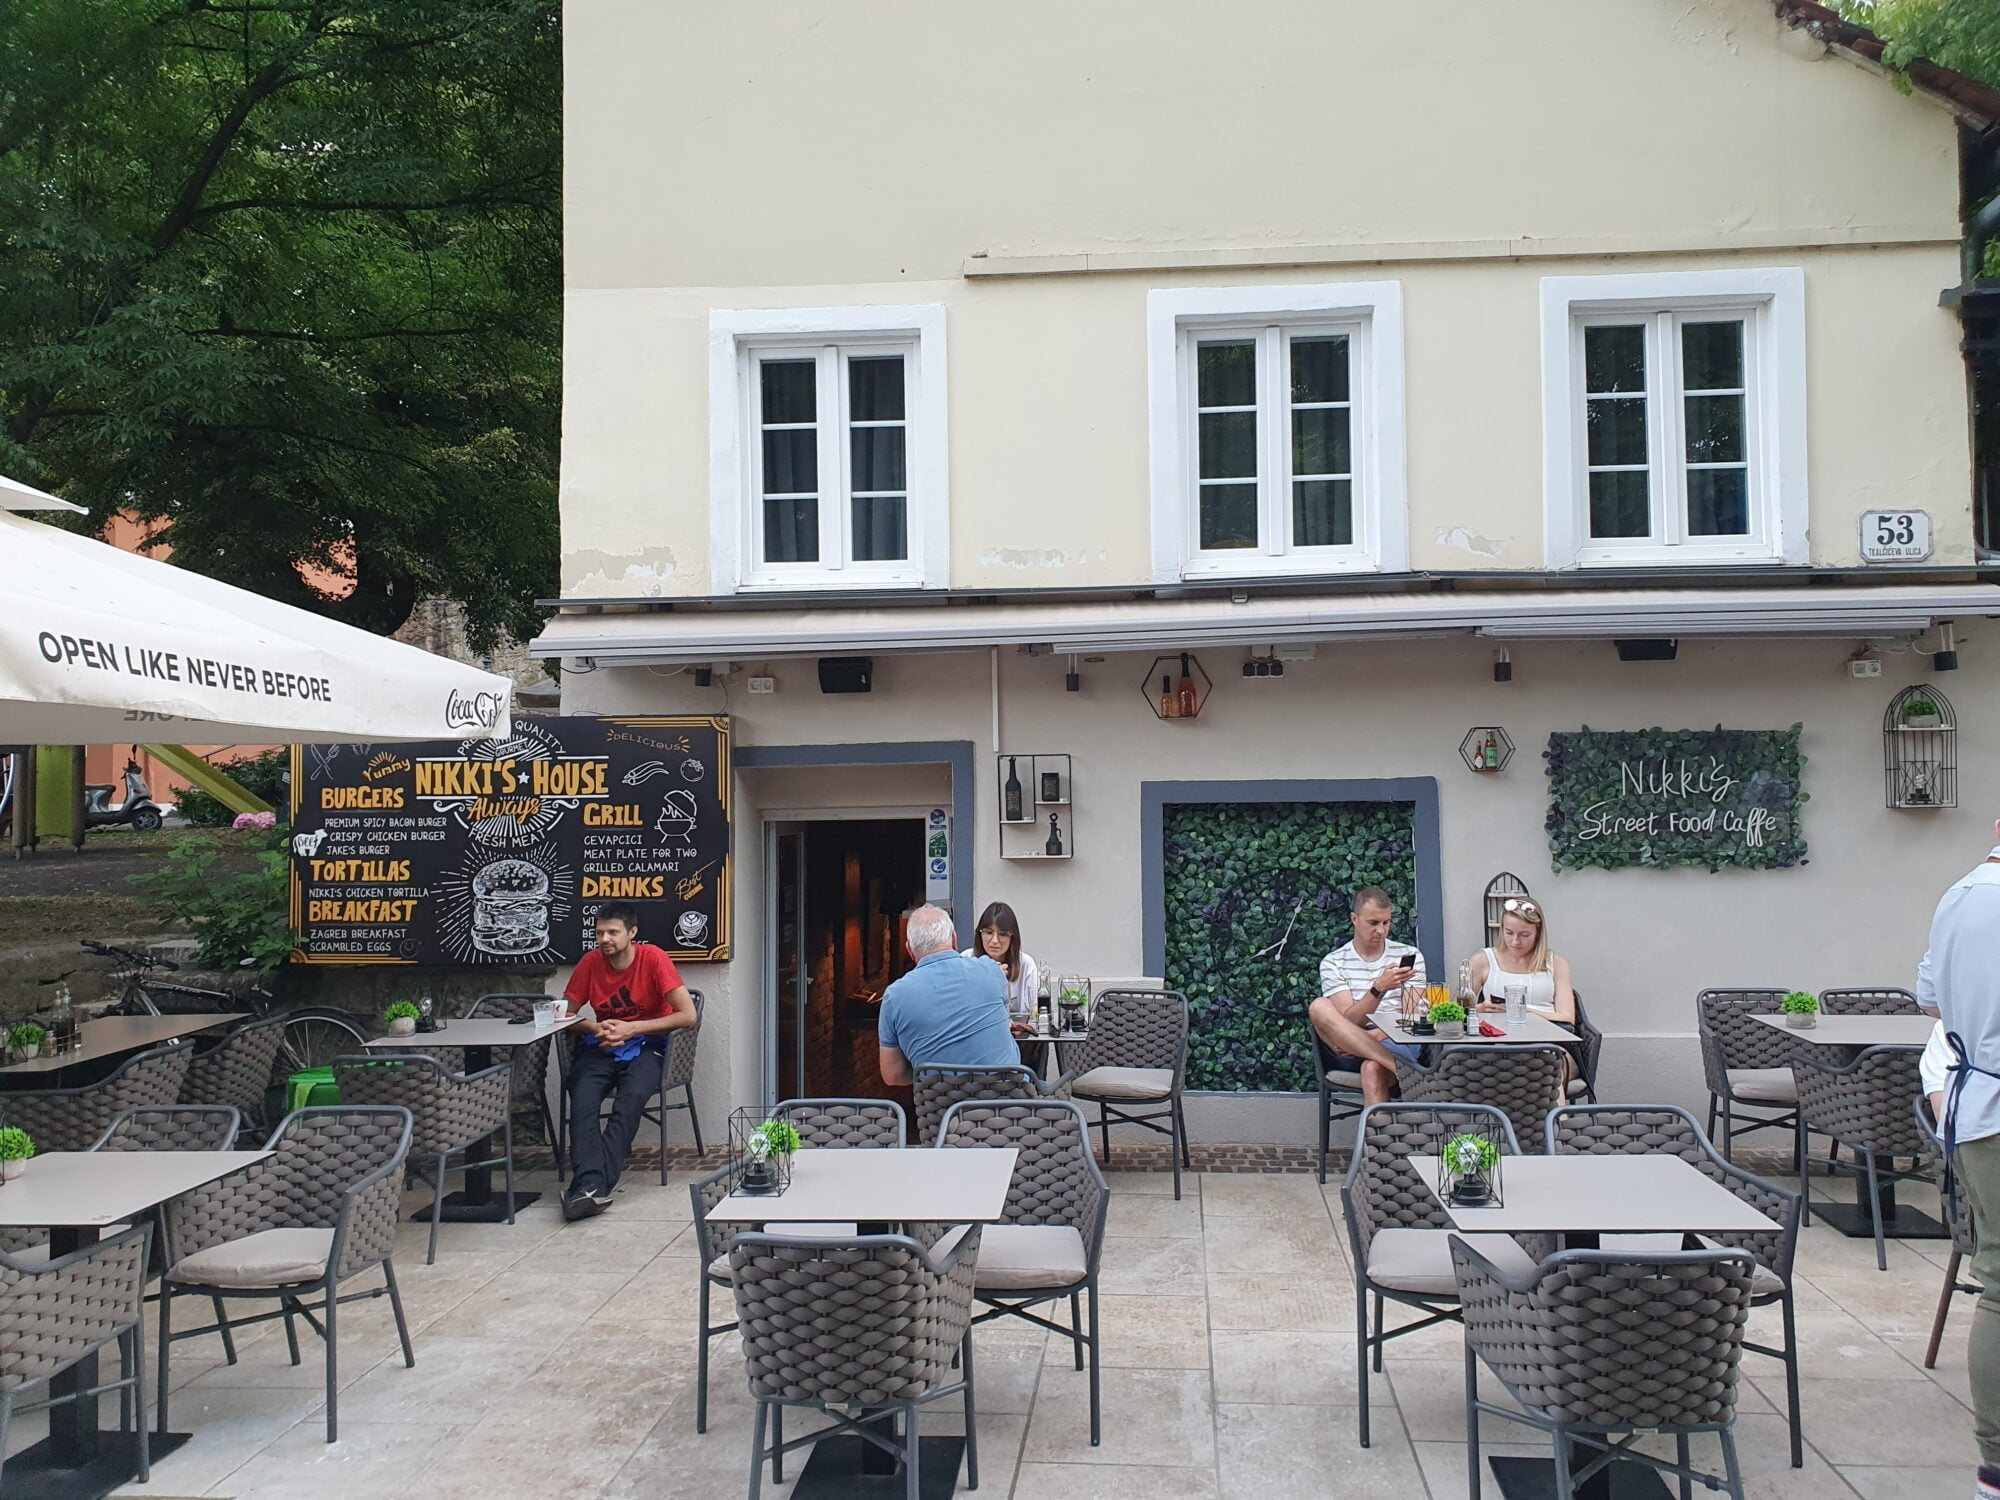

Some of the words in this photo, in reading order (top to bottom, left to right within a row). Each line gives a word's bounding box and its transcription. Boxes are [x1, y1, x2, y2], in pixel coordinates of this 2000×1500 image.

[1876, 514, 1914, 546] 53
[1905, 547, 1922, 556] ULICA
[38, 631, 120, 672] OPEN
[125, 645, 181, 682] LIKE
[186, 656, 258, 694] NEVER
[262, 669, 332, 702] BEFORE
[515, 720, 567, 754] QUALITY
[613, 732, 681, 751] DELICIOUS
[495, 741, 529, 757] GOURMET
[362, 758, 411, 782] Yummy
[415, 759, 517, 795] NIKKI'S
[533, 759, 610, 796] HOUSE
[1620, 755, 1740, 802] Nikki's
[321, 785, 405, 809] BURGERS
[466, 798, 541, 825] Always
[583, 802, 644, 826] GRILL
[325, 817, 360, 828] PREMIUM
[363, 817, 386, 828] SPICY
[389, 817, 415, 828] BACON
[418, 817, 448, 828] BURGER
[1578, 798, 1659, 840] Street
[1669, 808, 1717, 833] Food
[1723, 807, 1777, 848] Caffe
[330, 832, 363, 842] CRISPY
[367, 831, 409, 842] CHICKEN
[411, 831, 446, 841] BURGER
[468, 828, 506, 848] FRESH
[512, 828, 546, 848] MEAT
[584, 834, 643, 846] CEVAPCICI
[326, 845, 356, 856] JAKE'S
[359, 845, 390, 855] BURGER
[584, 849, 612, 859] MEAT
[616, 848, 648, 859] PLATE
[652, 848, 671, 858] FOR
[677, 848, 698, 858] TWO
[309, 859, 411, 882] TORTILLAS
[583, 862, 624, 873] GRILLED
[628, 861, 680, 873] CALAMARI
[309, 887, 343, 898] NIKKI'S
[346, 887, 384, 898] CHICKEN
[388, 887, 430, 898] TORTILLA
[581, 875, 665, 898] DRINKS
[308, 899, 418, 922] BREAKFAST
[582, 916, 596, 927] WI
[310, 929, 348, 939] ZAGREB
[351, 928, 407, 939] BREAKFAST
[582, 928, 596, 939] BE
[310, 941, 363, 952] SCRAMBLED
[367, 941, 392, 952] EGGS
